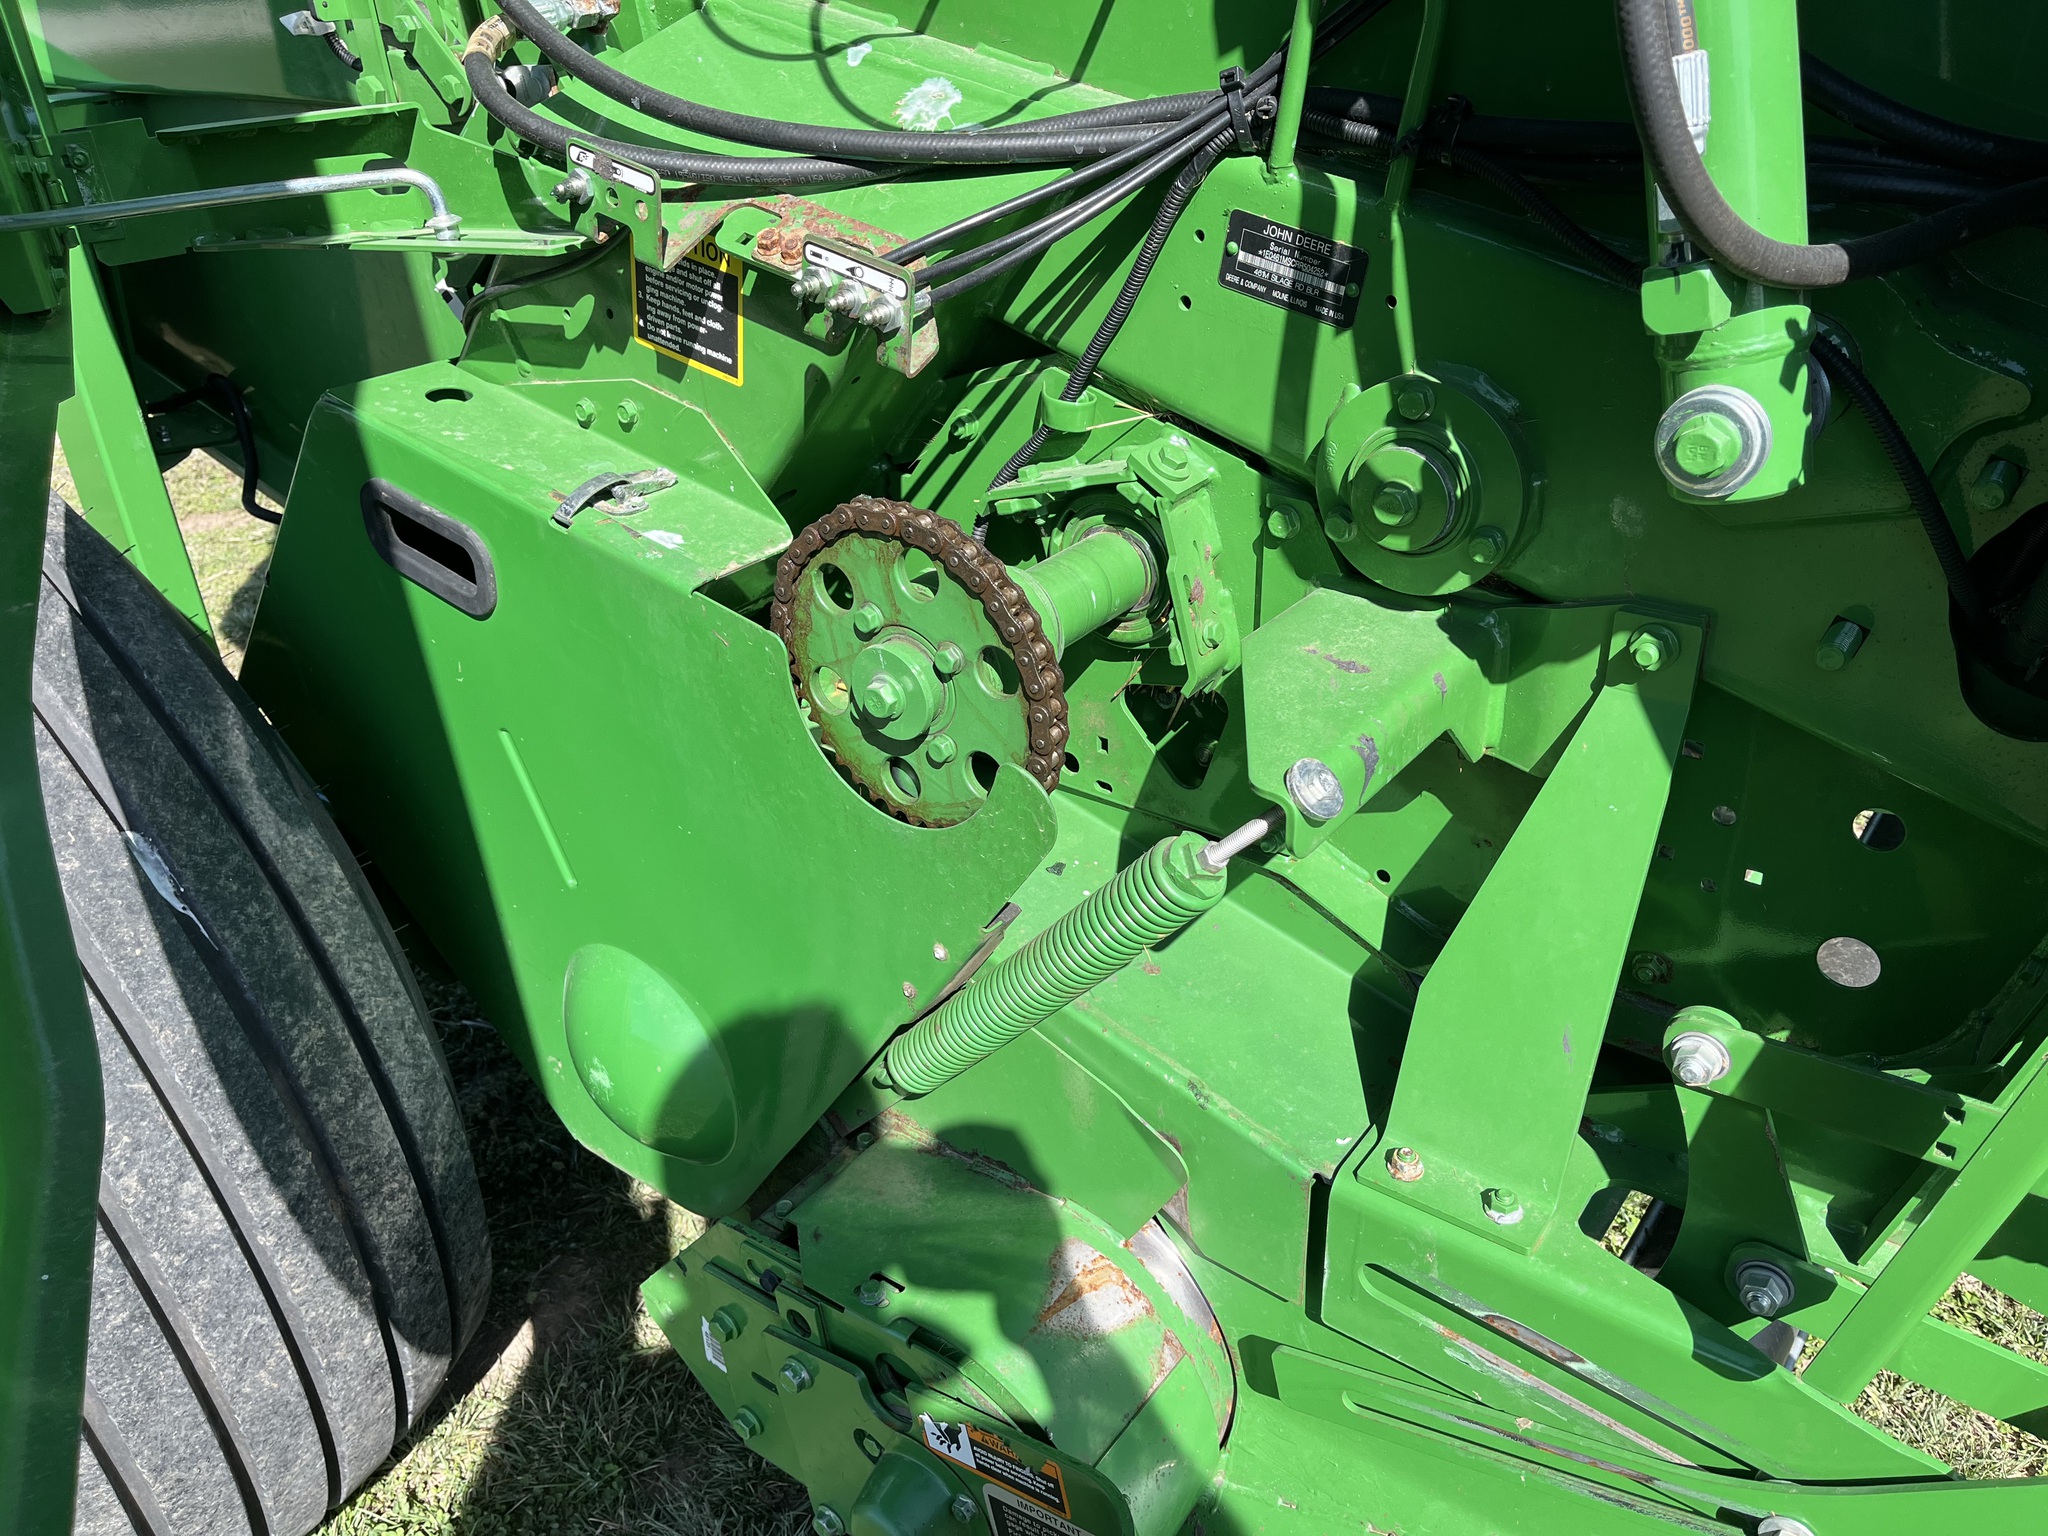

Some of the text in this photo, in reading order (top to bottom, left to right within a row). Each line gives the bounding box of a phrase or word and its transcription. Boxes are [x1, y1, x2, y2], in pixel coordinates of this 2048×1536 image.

[1263, 224, 1332, 256] JOHN DEERE
[1269, 241, 1321, 266] Serial Number
[645, 265, 665, 279] engine
[666, 273, 685, 287] and/or
[685, 281, 704, 294] motor
[704, 289, 723, 302] power
[676, 268, 688, 278] and
[689, 272, 703, 284] shut
[703, 278, 712, 288] off
[713, 281, 721, 291] all
[698, 266, 717, 279] place.
[1253, 268, 1270, 279] 461M
[645, 273, 724, 313] before servicing or unclog-
[645, 285, 687, 307] ging machine.
[1225, 272, 1240, 285] DEERE
[1244, 279, 1268, 294] COMPANY
[1315, 304, 1329, 316] MADE
[1328, 308, 1334, 319] IN
[1334, 311, 1345, 321] USA
[637, 290, 725, 332] 3. Keep hands, feet and cloth-
[646, 302, 708, 334] ing away from power-
[646, 313, 683, 335] driven parts.
[646, 321, 656, 332] Do
[656, 327, 667, 338] not
[667, 330, 682, 344] leave
[682, 338, 706, 356] running
[706, 347, 733, 365] machine
[647, 332, 682, 353] unattended.
[1002, 1505, 1031, 1525] Damage
[1032, 1520, 1041, 1529] to
[1004, 1513, 1018, 1523] can
[1019, 1520, 1040, 1535] result
[1016, 1498, 1081, 1536] IMPORTANT
